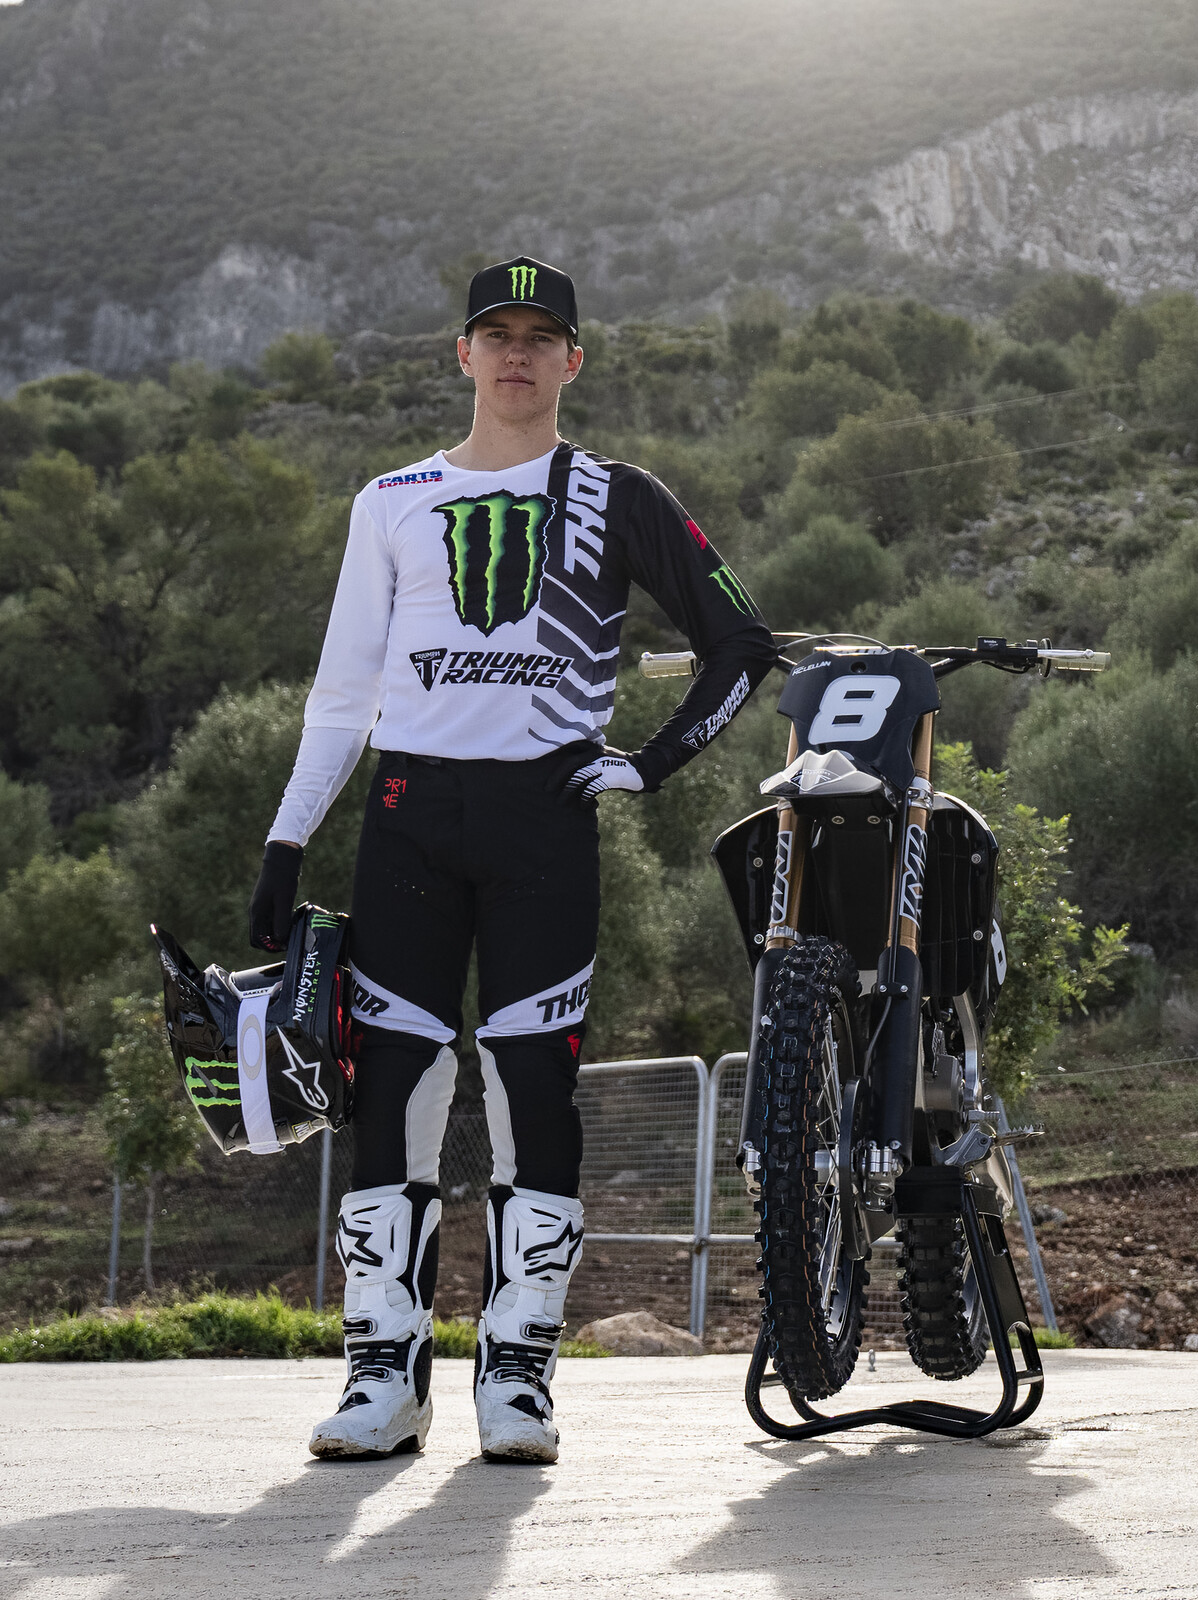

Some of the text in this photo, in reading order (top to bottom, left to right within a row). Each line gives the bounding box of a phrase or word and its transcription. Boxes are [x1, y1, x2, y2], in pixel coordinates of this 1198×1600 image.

[378, 470, 443, 484] PARTS
[440, 668, 562, 689] RACING
[449, 651, 573, 675] TRIUMPH
[807, 674, 901, 746] 8
[600, 759, 627, 767] THOR
[292, 950, 319, 1021] MONSTER
[307, 961, 321, 1013] ENERGY
[536, 975, 593, 1025] THO
